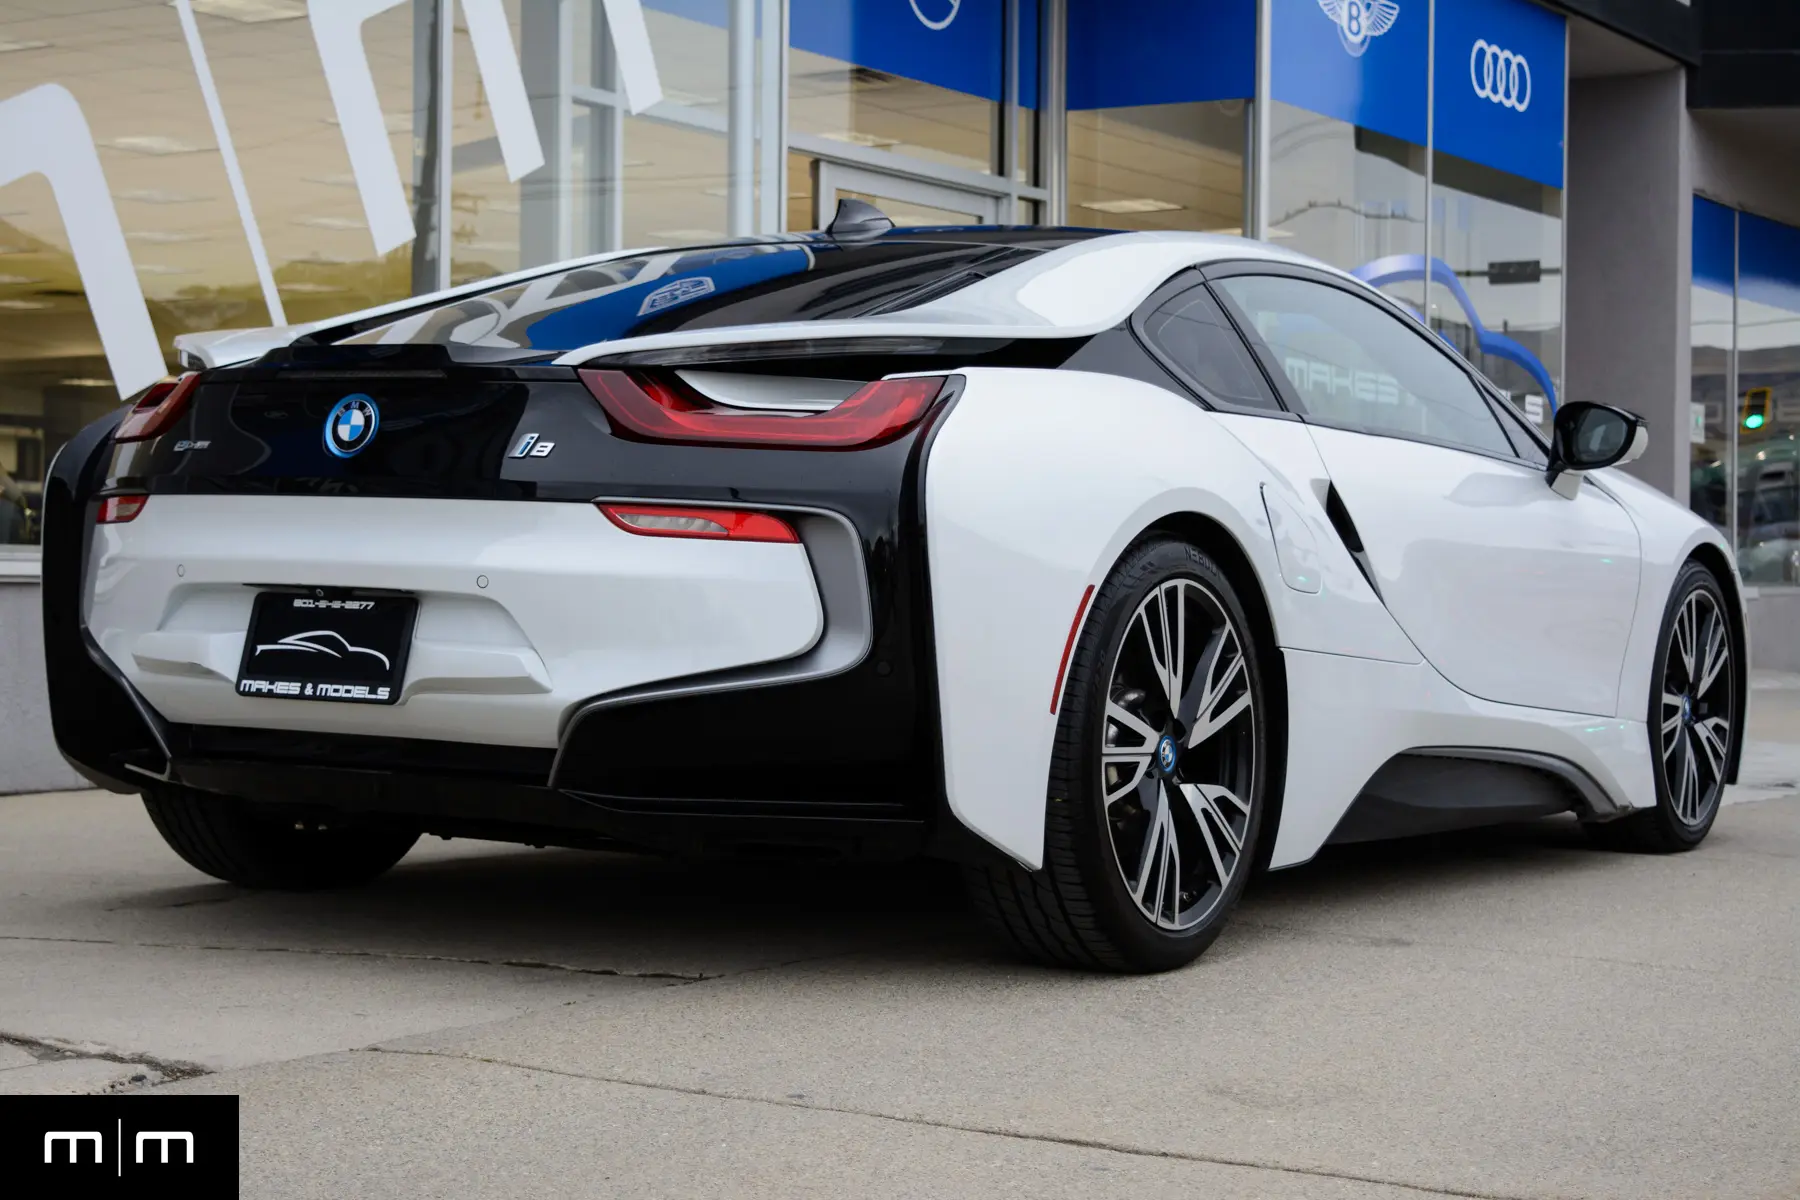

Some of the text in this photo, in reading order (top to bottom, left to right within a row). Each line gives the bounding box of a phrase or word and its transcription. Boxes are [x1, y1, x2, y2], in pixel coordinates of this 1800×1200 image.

[337, 400, 372, 417] BMW
[508, 433, 555, 458] i8
[239, 679, 391, 700] MAKES & MODELS
